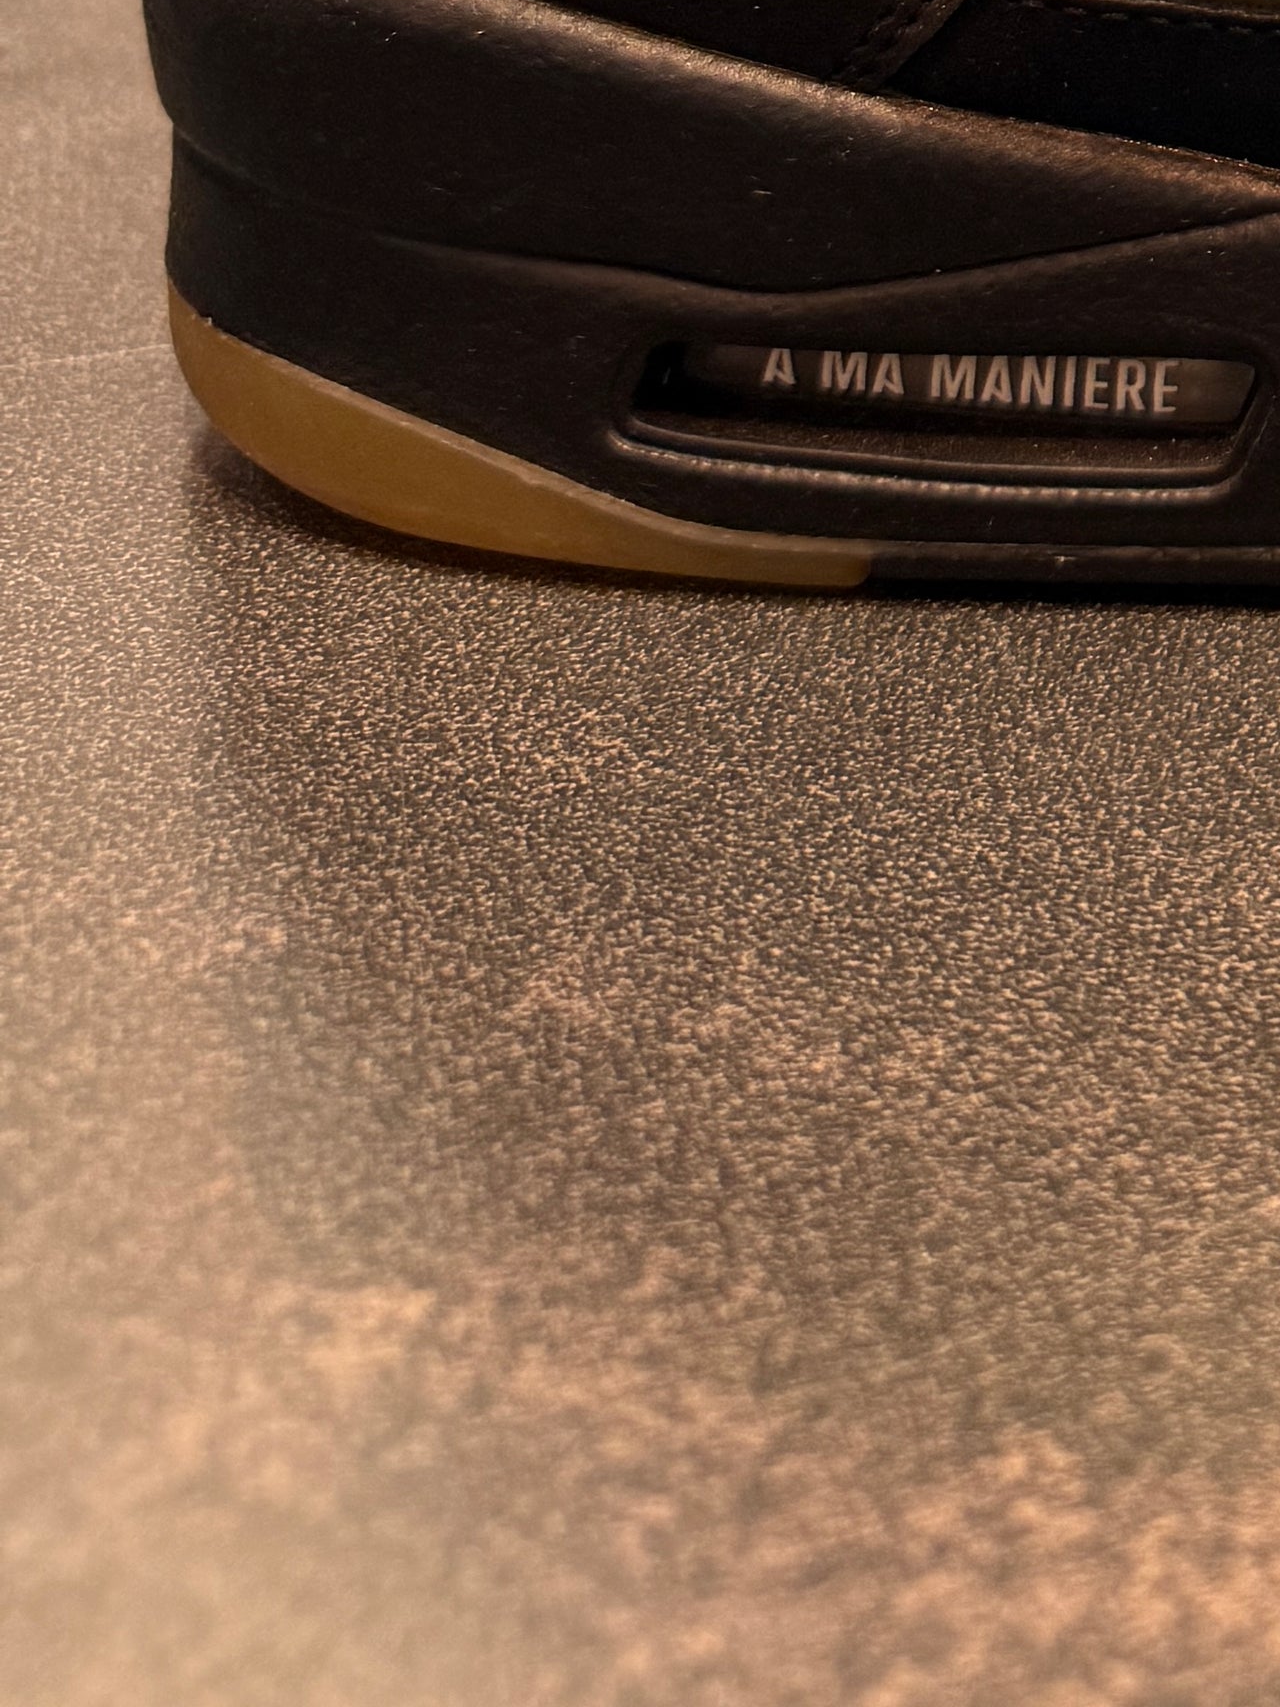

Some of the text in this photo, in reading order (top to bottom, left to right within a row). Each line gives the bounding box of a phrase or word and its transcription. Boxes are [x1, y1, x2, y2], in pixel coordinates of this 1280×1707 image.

[762, 348, 1180, 413] A MA MANIERE
